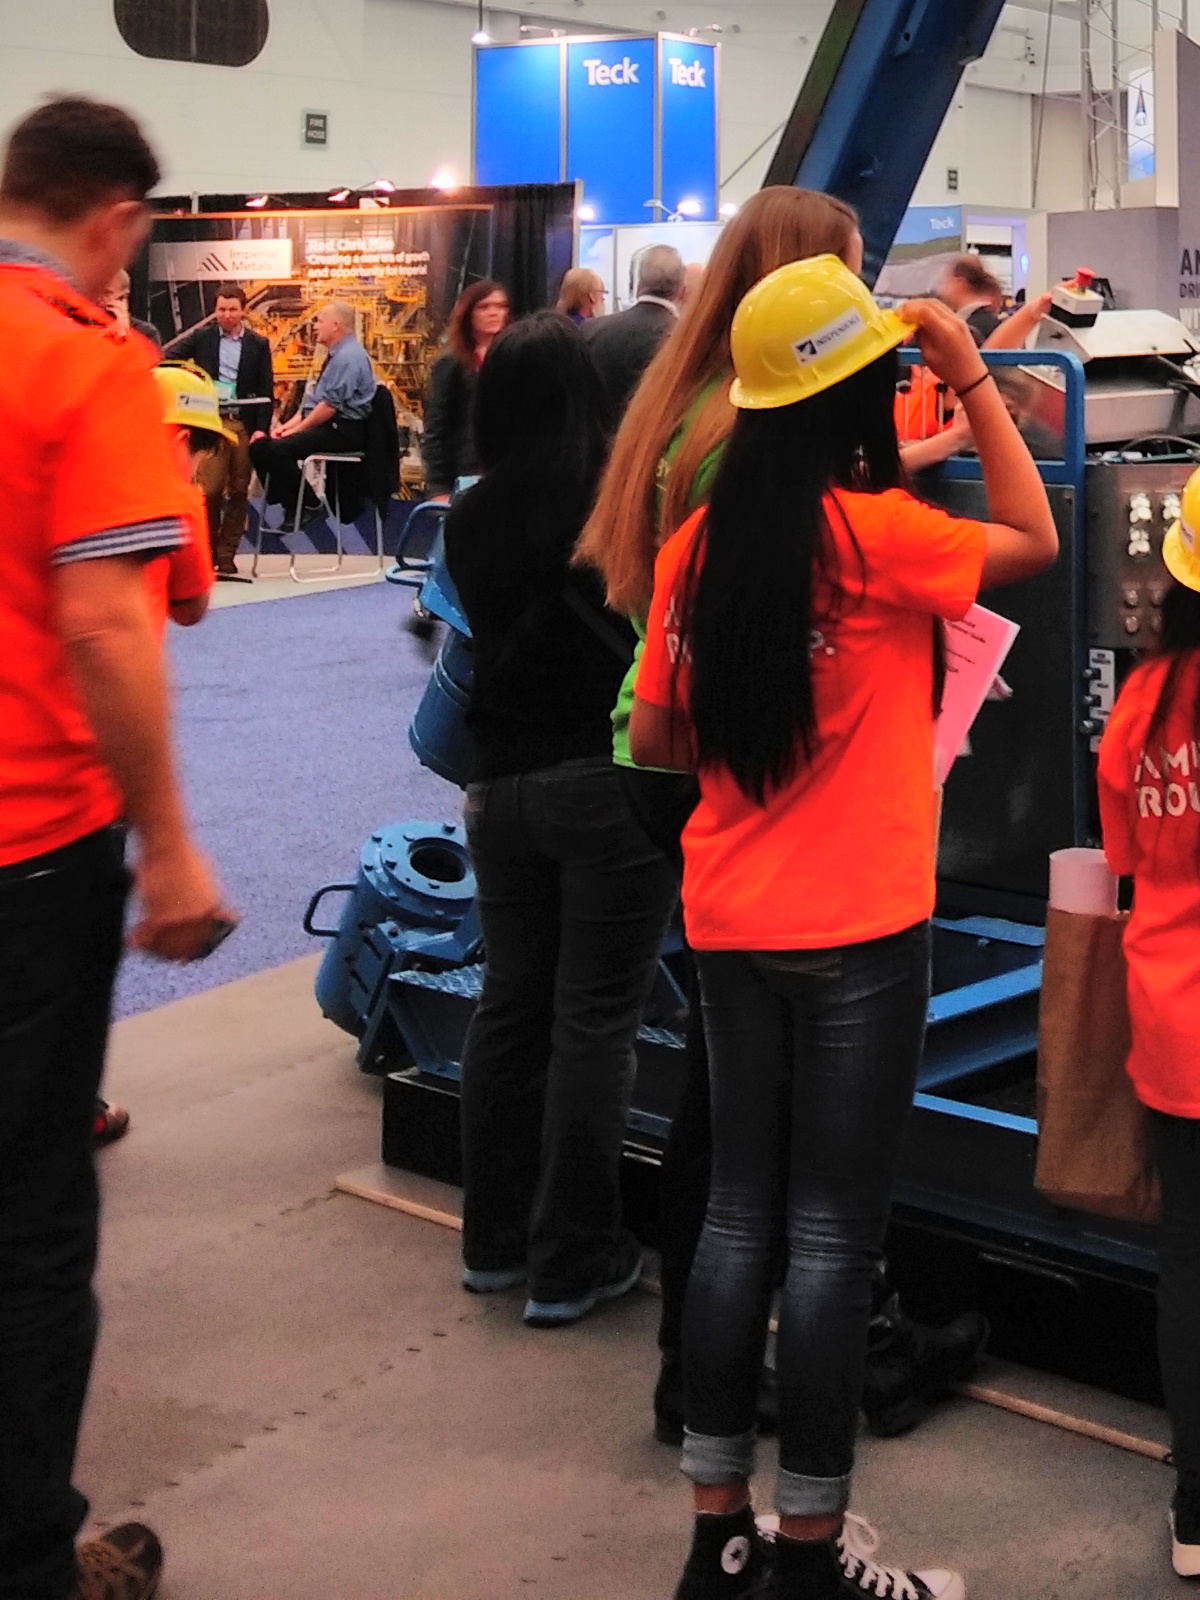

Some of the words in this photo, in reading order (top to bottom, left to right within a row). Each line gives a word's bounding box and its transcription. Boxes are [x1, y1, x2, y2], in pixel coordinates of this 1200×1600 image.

[583, 57, 640, 86] Teck
[668, 58, 706, 87] Teck
[929, 217, 954, 229] Teck
[306, 238, 335, 251] Red
[229, 249, 278, 263] Imperial
[306, 253, 349, 267] Creating
[231, 260, 273, 271] Metals
[307, 267, 329, 277] and
[330, 266, 385, 279] opportunity
